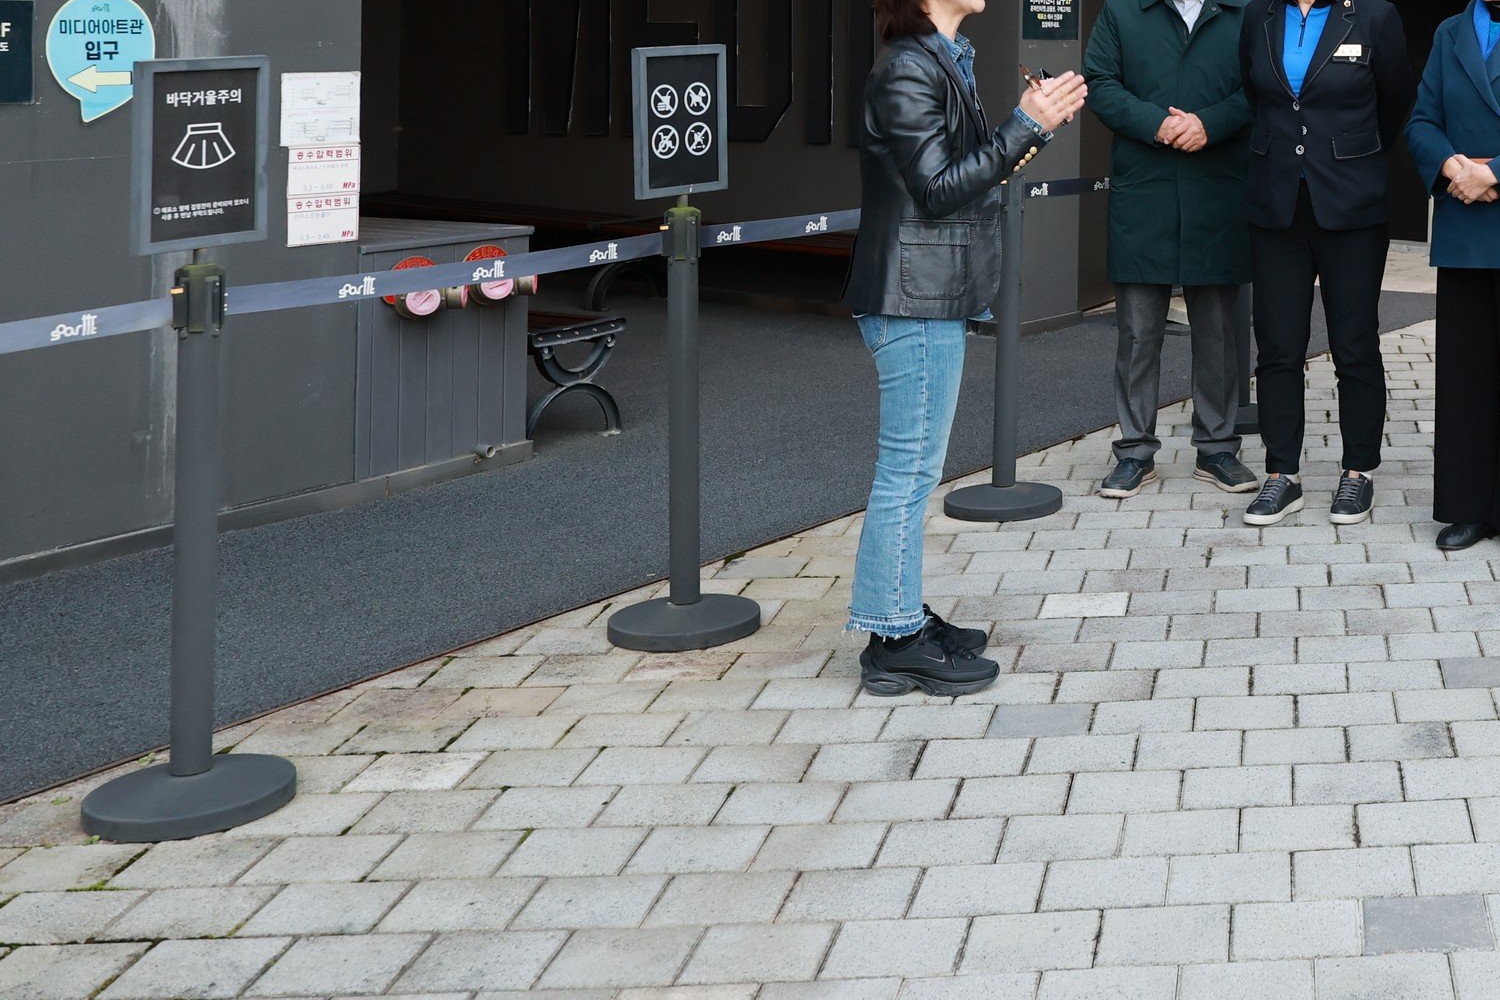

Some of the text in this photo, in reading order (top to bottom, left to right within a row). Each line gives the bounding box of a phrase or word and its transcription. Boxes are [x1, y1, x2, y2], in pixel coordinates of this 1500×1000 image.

[59, 19, 143, 35] 미디어아트관
[85, 41, 119, 60] 입구
[166, 88, 242, 107] 바닥거울주의
